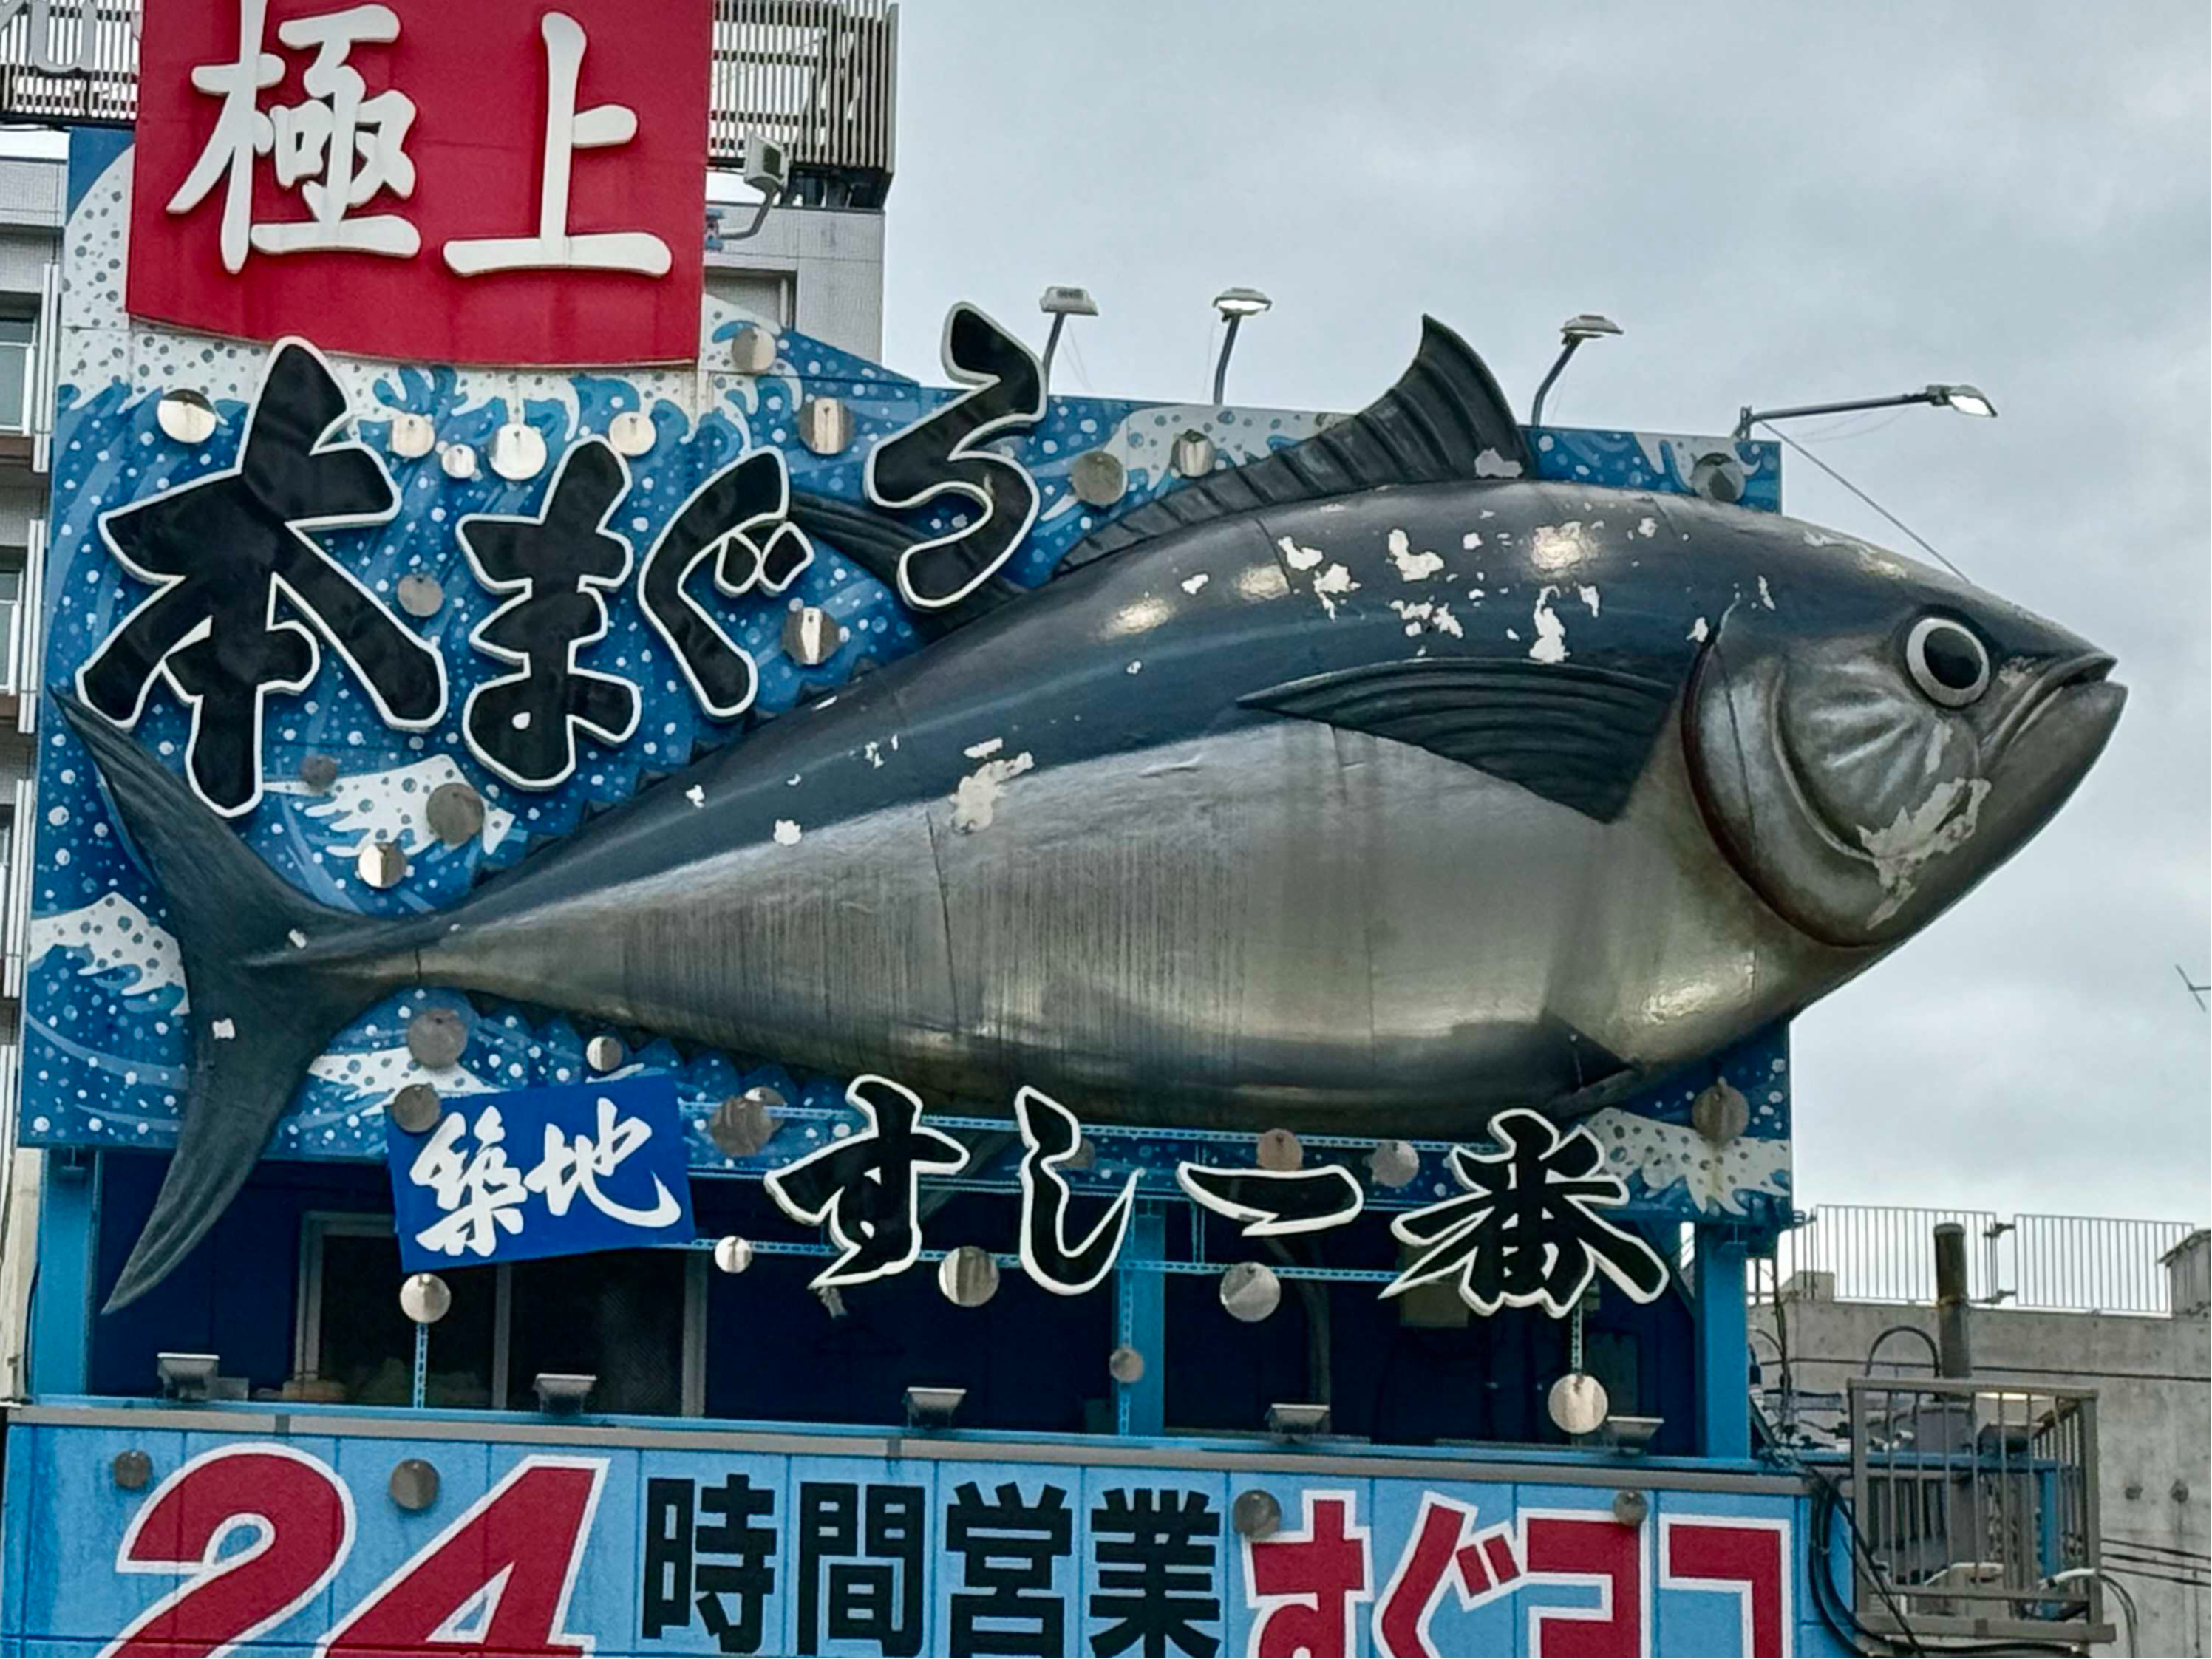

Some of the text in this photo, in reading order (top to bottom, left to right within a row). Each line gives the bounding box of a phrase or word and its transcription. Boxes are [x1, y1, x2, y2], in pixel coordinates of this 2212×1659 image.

[166, 0, 673, 277] 極上
[75, 301, 1047, 818] 本まぐろ
[409, 1097, 682, 1257] 築地
[765, 1074, 1669, 1318] すし一番
